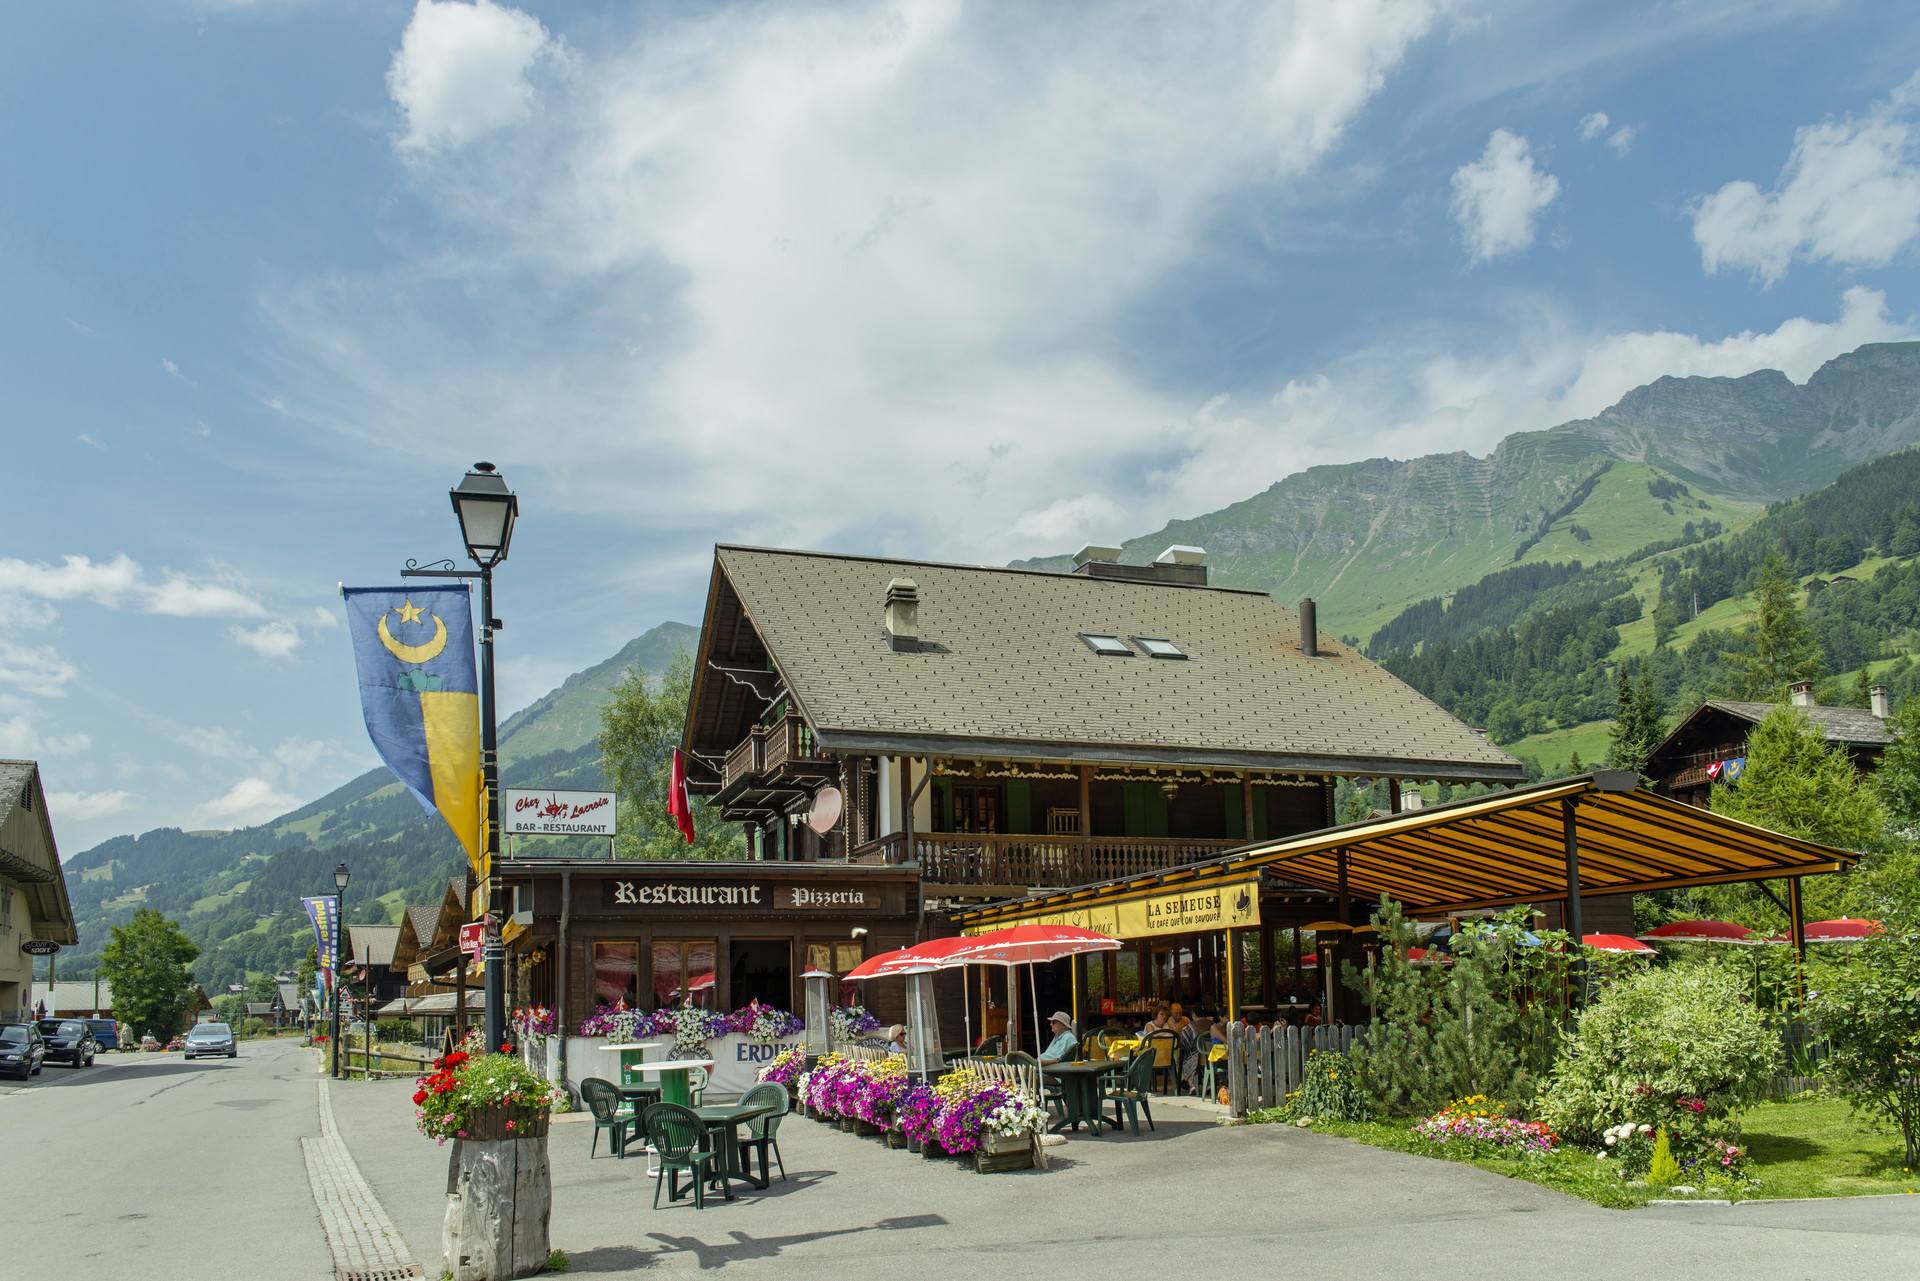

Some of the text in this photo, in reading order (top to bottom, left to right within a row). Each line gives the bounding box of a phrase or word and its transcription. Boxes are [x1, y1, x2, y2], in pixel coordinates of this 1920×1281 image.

[515, 797, 610, 819] Chez Lacroix
[614, 881, 762, 904] Restaurant
[791, 887, 865, 907] Pizzeria
[1148, 895, 1221, 917] LA SEMEUSE
[1149, 920, 1155, 929] LE
[1170, 917, 1180, 927] QUE
[1194, 912, 1221, 924] SAVOURE
